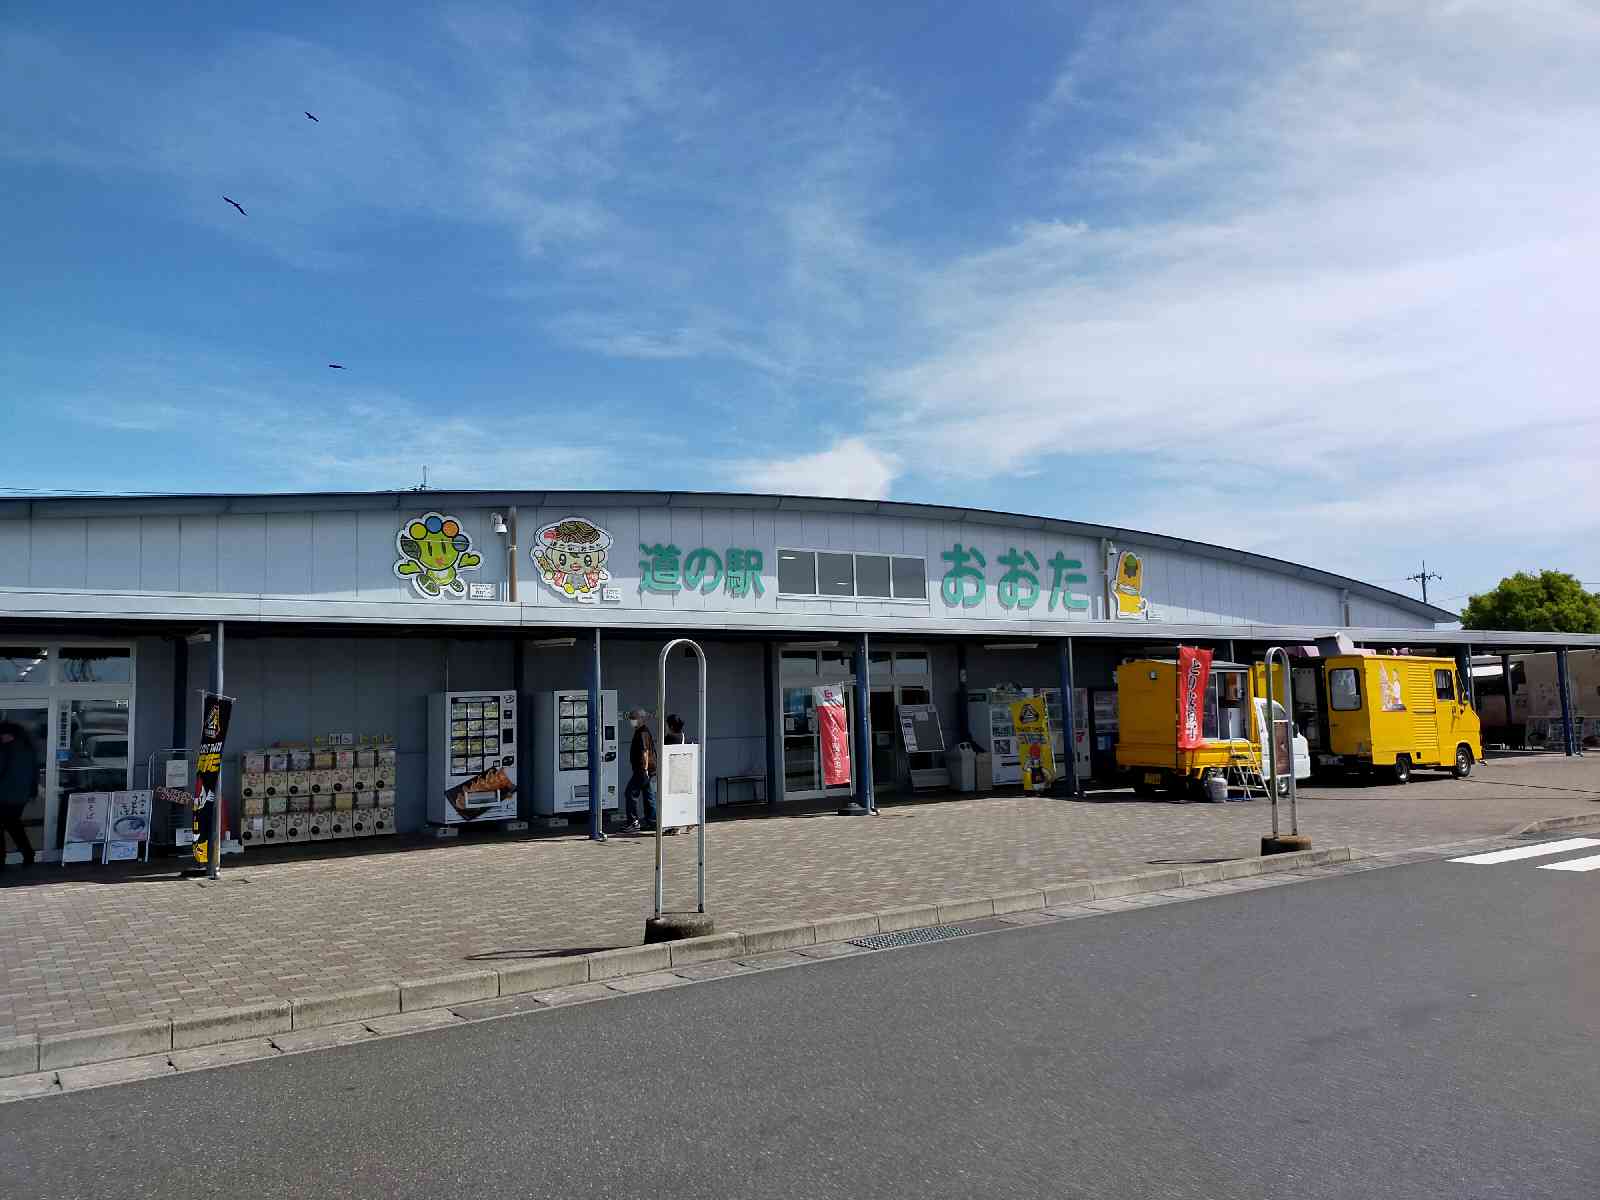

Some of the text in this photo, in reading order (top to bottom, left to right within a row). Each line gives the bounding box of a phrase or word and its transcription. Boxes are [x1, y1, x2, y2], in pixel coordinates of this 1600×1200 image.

[638, 543, 1090, 611] 道の駅 おおた
